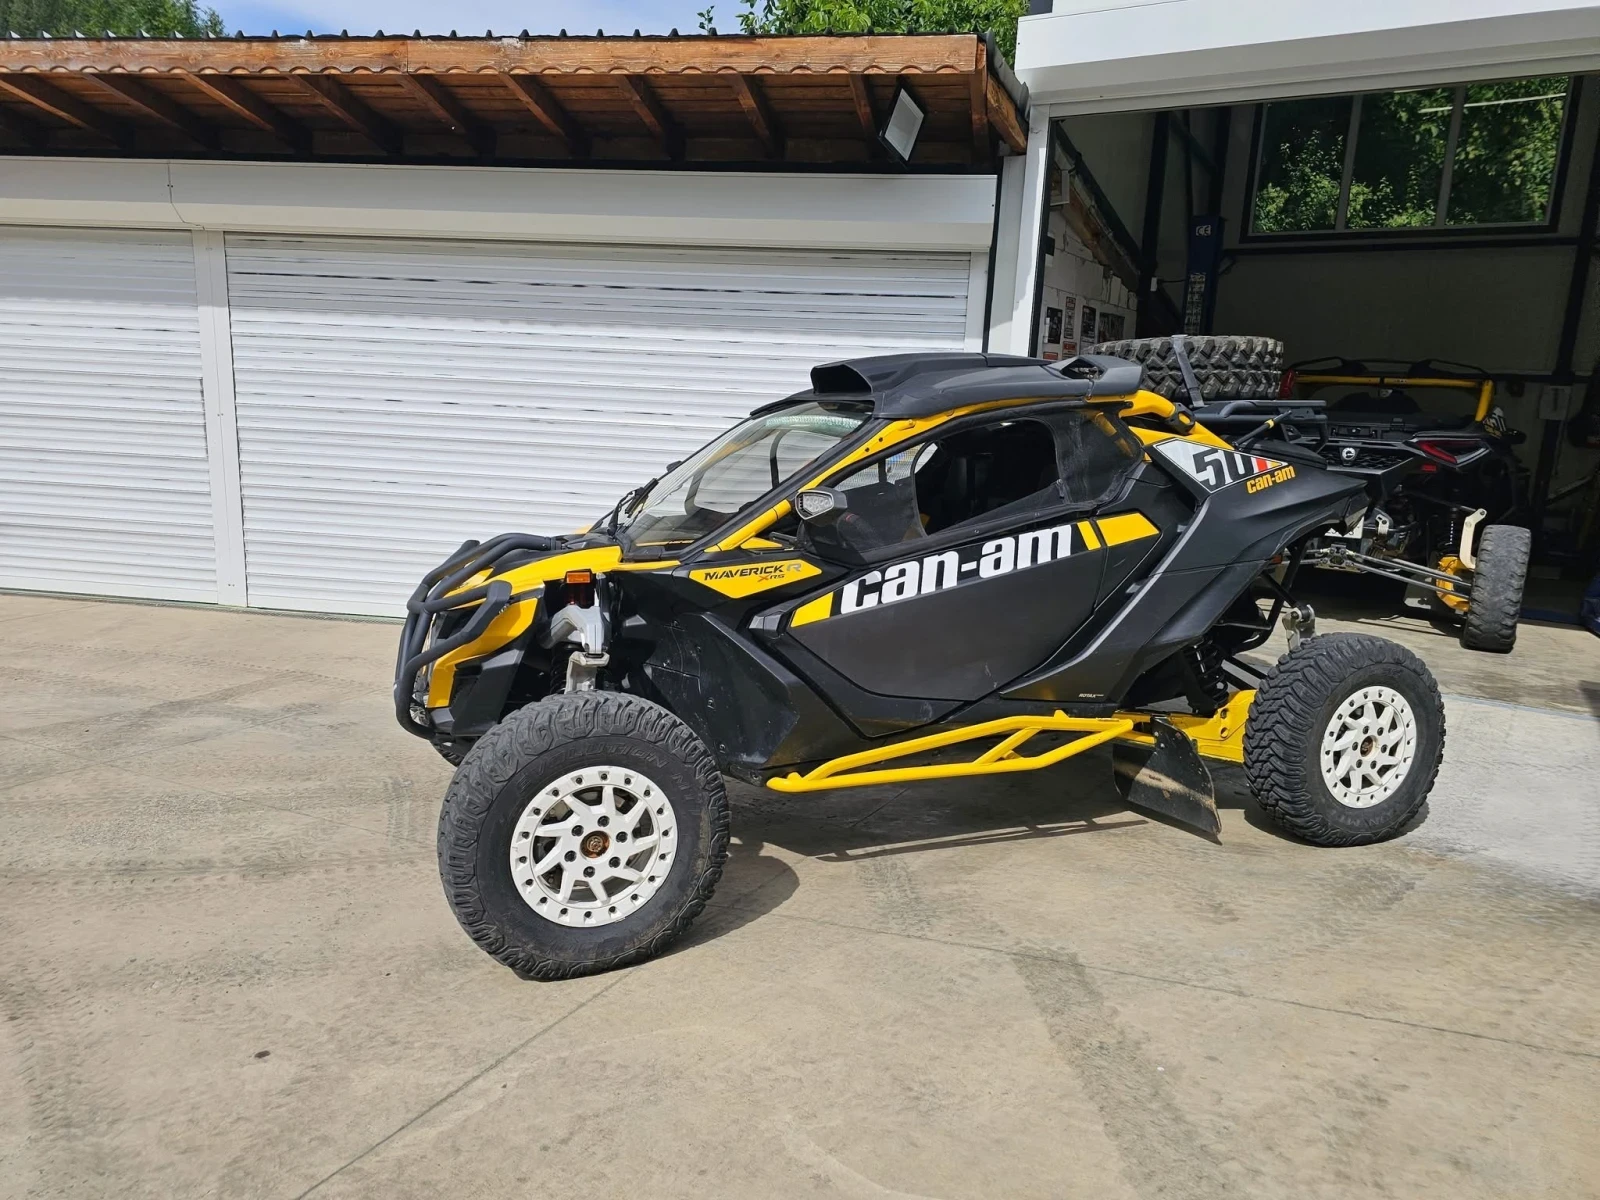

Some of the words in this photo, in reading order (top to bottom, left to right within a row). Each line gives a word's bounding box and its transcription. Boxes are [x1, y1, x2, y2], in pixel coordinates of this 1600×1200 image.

[1196, 225, 1210, 235] CE
[1193, 447, 1255, 491] 50
[1246, 465, 1296, 494] can-am
[703, 564, 784, 581] MAVERICK
[786, 563, 802, 573] R
[840, 524, 1072, 615] can-am
